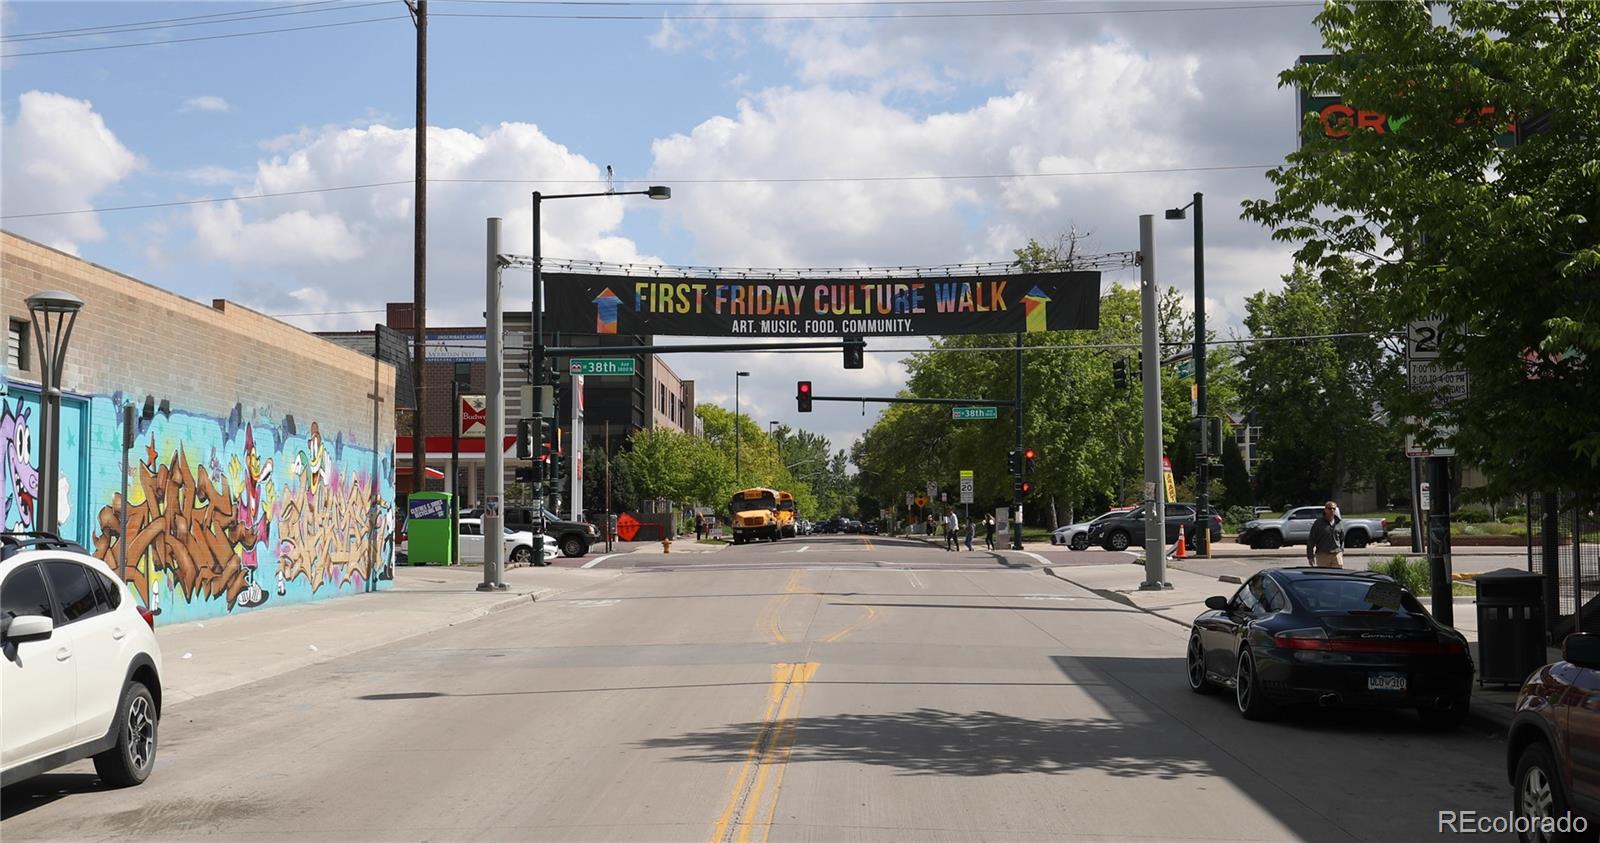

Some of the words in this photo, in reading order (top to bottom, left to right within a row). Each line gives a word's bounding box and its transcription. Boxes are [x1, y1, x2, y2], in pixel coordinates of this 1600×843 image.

[635, 282, 707, 314] FIRST
[715, 284, 805, 316] FRIDAY
[814, 283, 926, 316] CULTURE
[934, 280, 1007, 313] WALK
[732, 319, 757, 334] ART.
[761, 319, 801, 333] MUSIC.
[805, 319, 838, 333] FOOD.
[842, 318, 914, 333] COMMUNITY.
[588, 361, 616, 373] 38th
[964, 409, 985, 418] 38th
